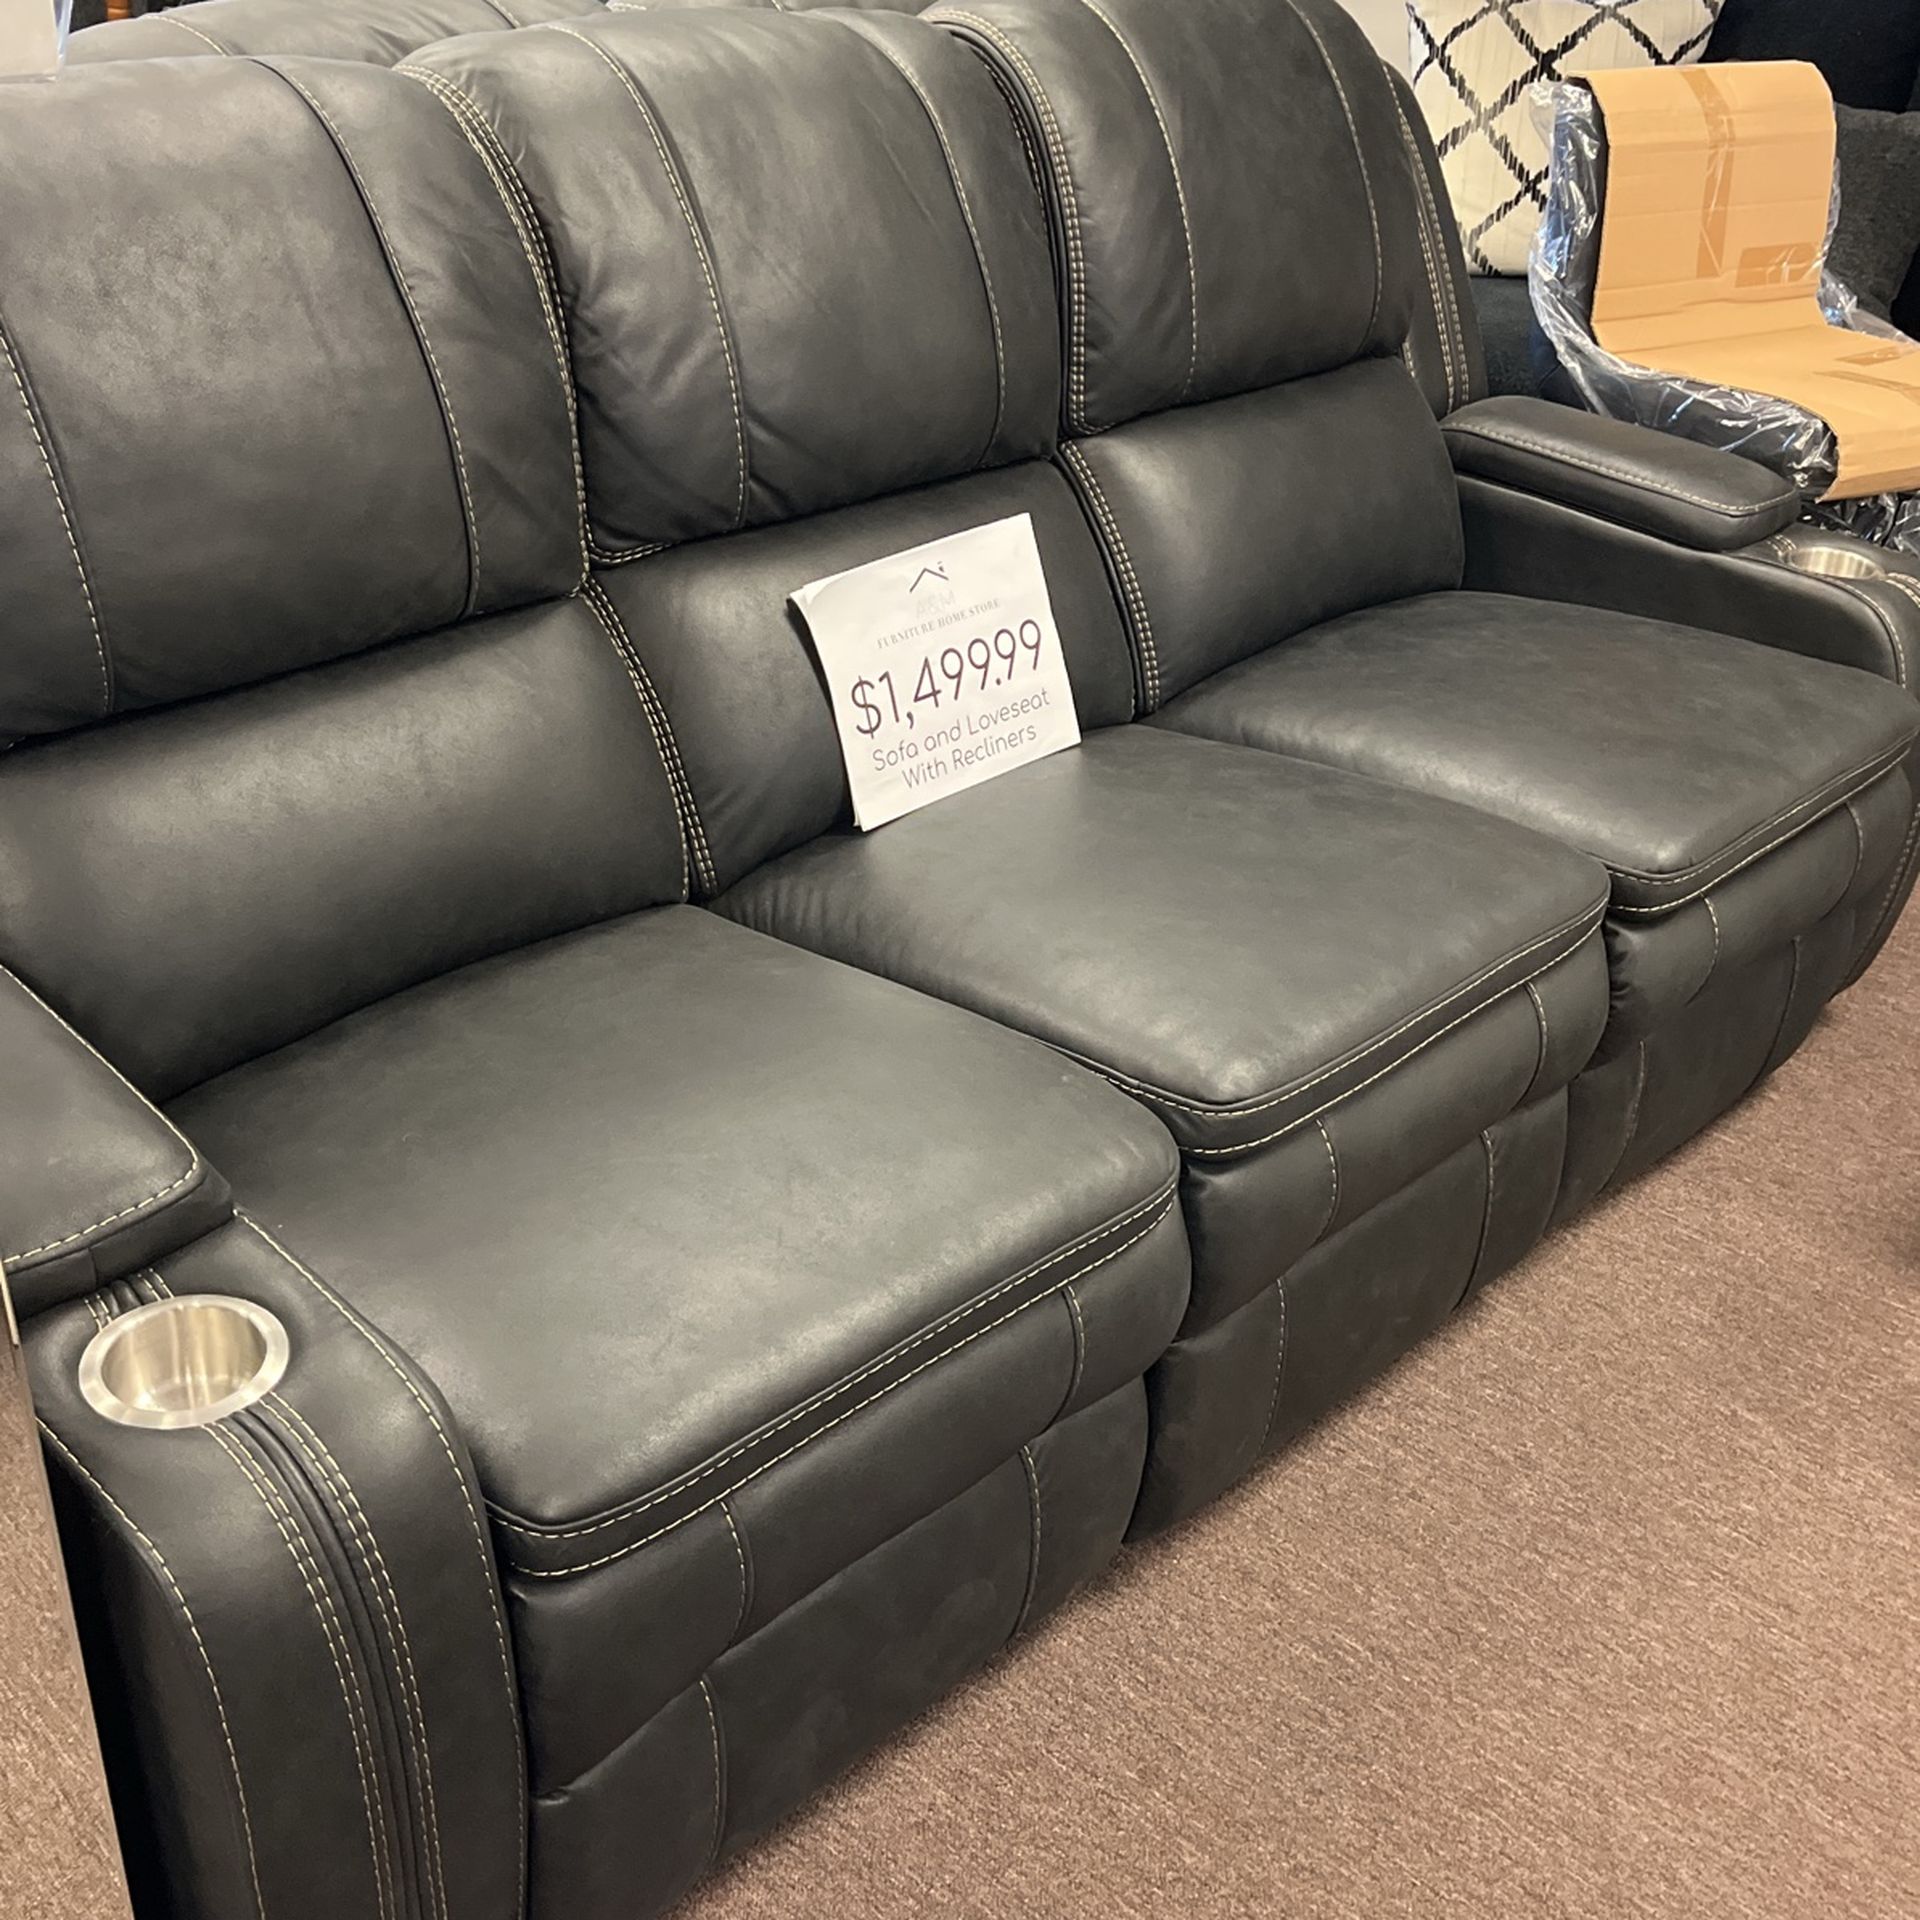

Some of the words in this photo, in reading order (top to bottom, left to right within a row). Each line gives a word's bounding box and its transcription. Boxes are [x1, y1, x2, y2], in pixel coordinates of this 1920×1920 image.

[876, 620, 936, 649] FURNITURE
[937, 609, 968, 628] HOME
[968, 598, 1001, 616] STORE
[851, 619, 1042, 739] $1,499.99
[872, 740, 919, 772] Sofa
[924, 722, 962, 753] and
[966, 687, 1051, 736] Loveseat
[901, 755, 949, 790] With
[952, 722, 1037, 770] Recliners
